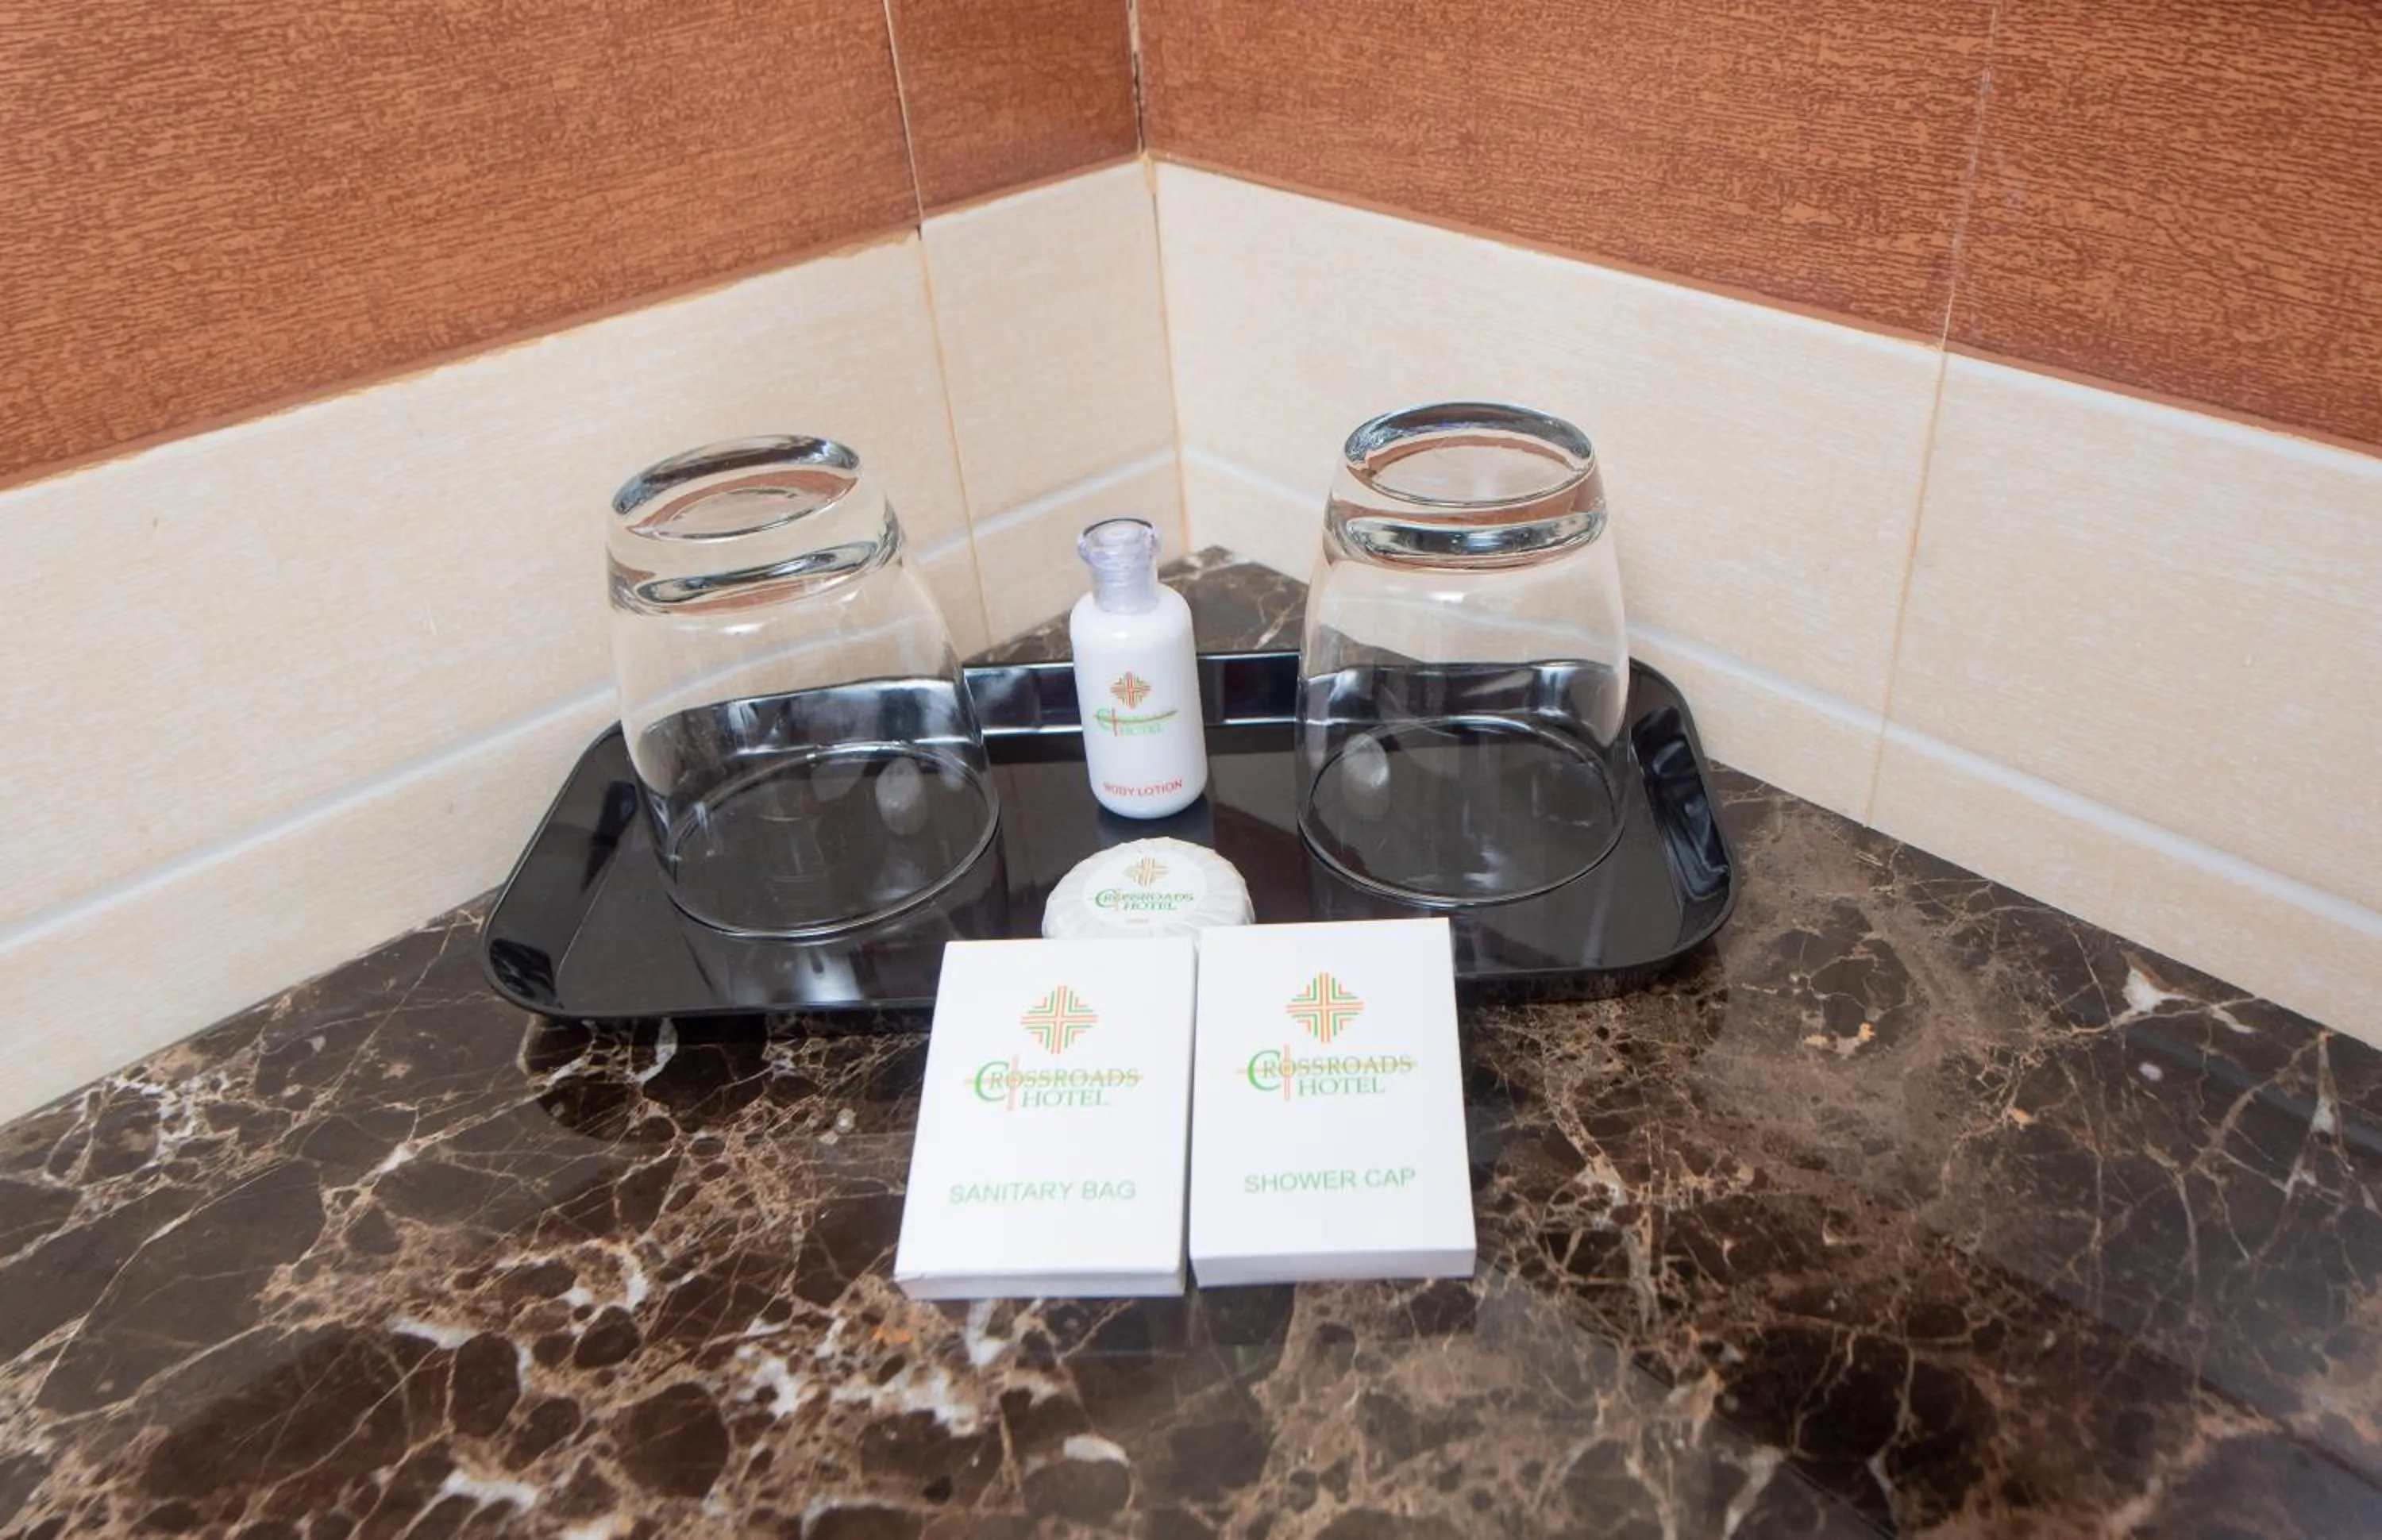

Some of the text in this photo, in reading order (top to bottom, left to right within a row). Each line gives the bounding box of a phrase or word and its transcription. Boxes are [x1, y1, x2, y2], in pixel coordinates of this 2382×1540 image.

[1138, 778, 1182, 796] LOTION
[1123, 901, 1178, 911] HOTEL
[974, 1060, 1141, 1102] CROSSROADS
[1247, 1049, 1413, 1091] CROSSROADS
[1020, 1088, 1110, 1108] HOTEL
[1297, 1076, 1386, 1097] HOTEL
[1243, 1167, 1416, 1193] SHOWER CAP
[949, 1179, 1137, 1205] SANITARY BAG
